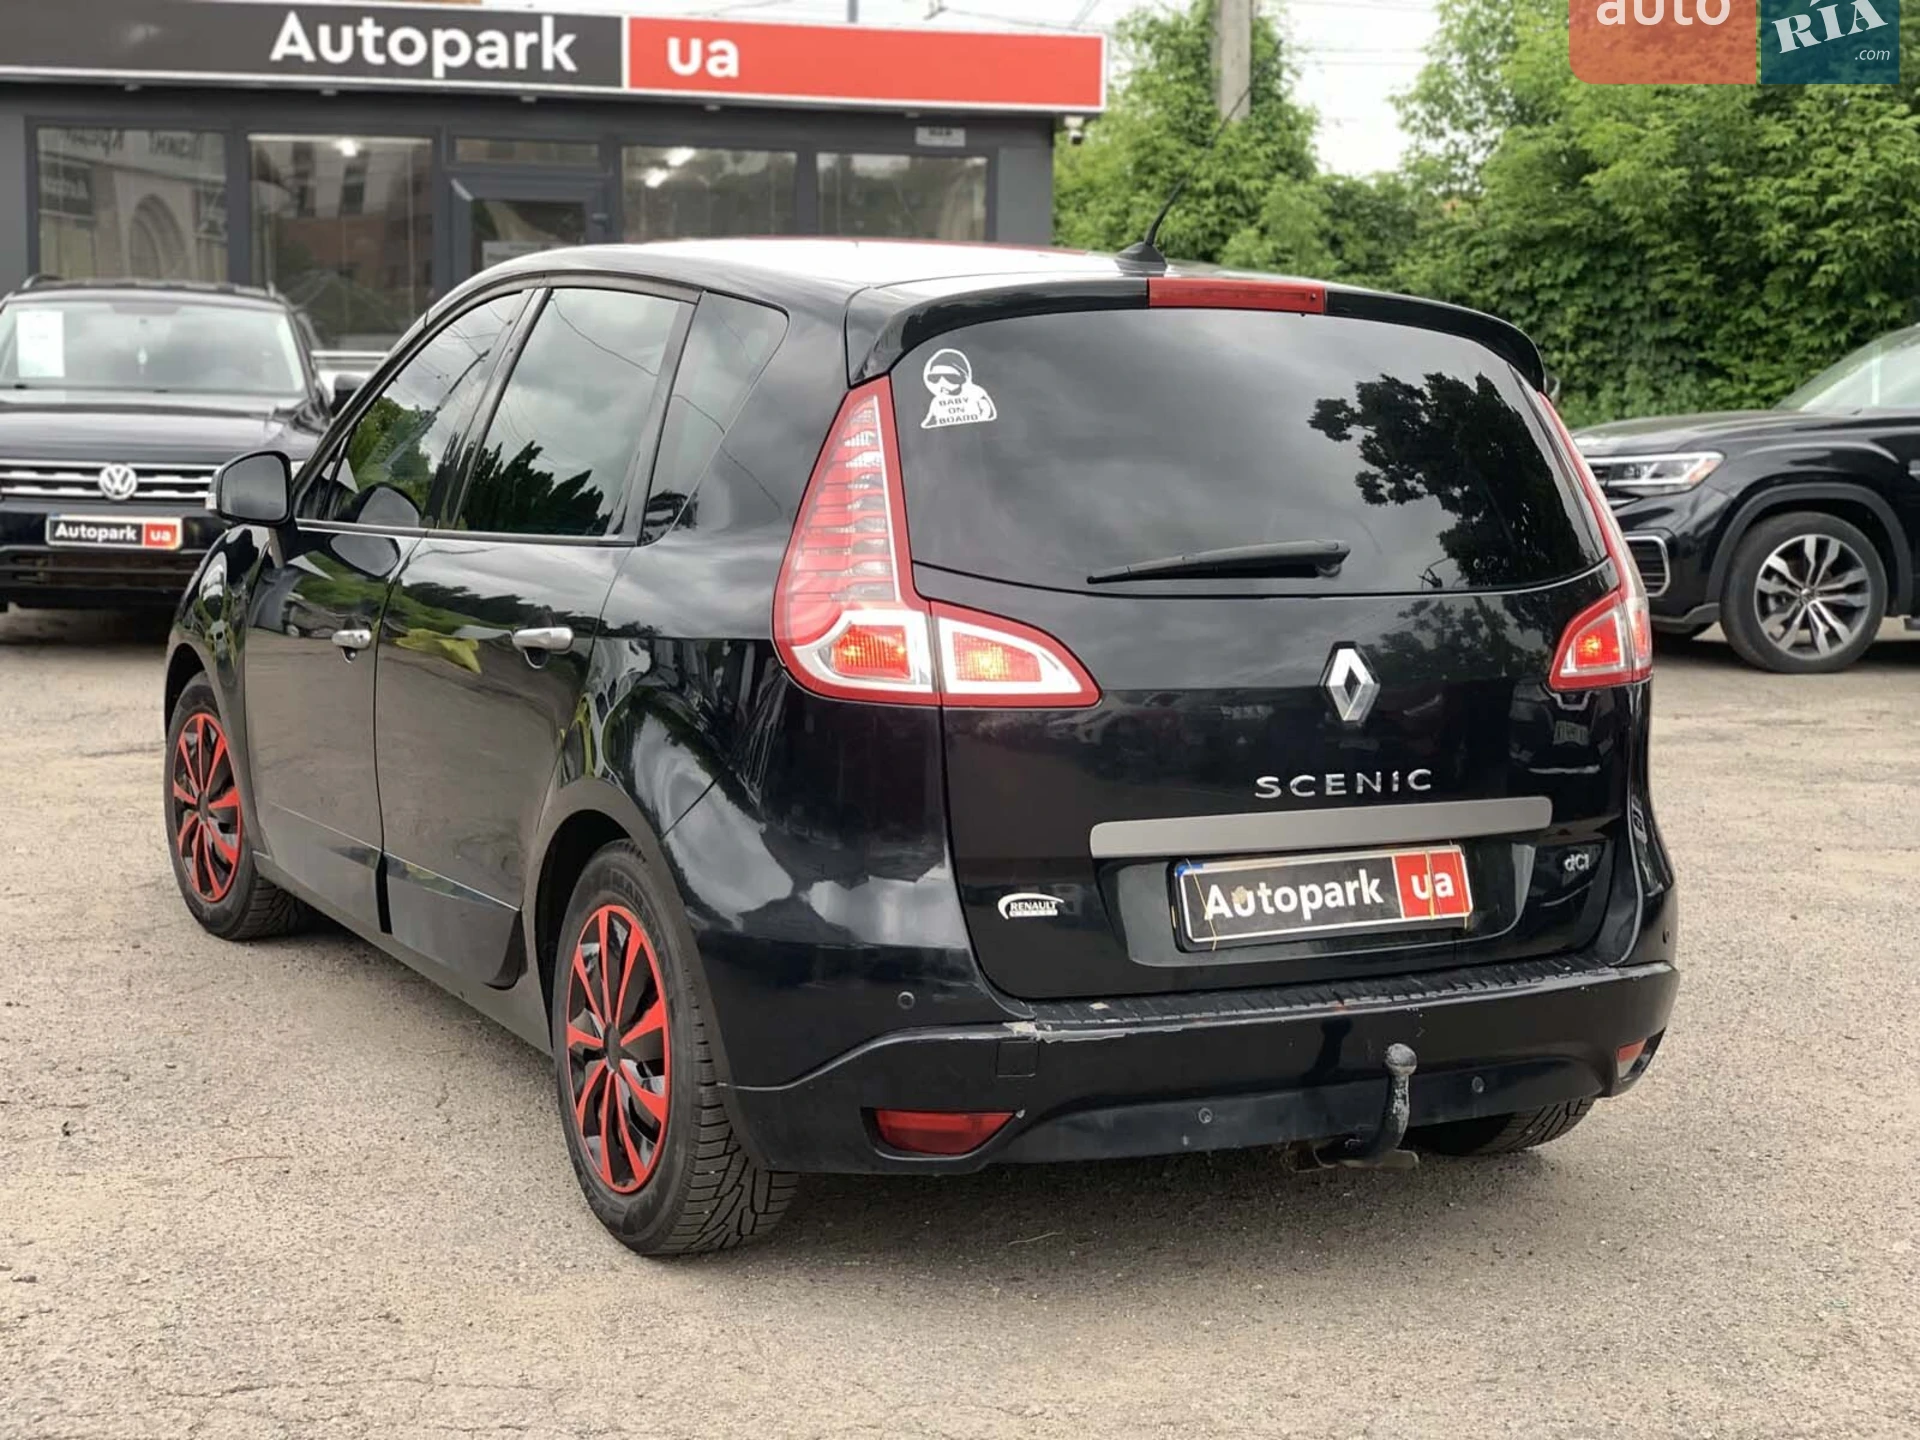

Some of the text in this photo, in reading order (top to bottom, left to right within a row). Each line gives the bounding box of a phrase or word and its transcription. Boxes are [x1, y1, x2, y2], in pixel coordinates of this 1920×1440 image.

[269, 11, 740, 79] Autopark ua
[938, 397, 969, 406] BABY
[939, 414, 978, 425] BOARD
[54, 522, 171, 542] Autopark ua
[1204, 868, 1455, 921] Autopark ua
[1010, 900, 1057, 911] RENAULT
